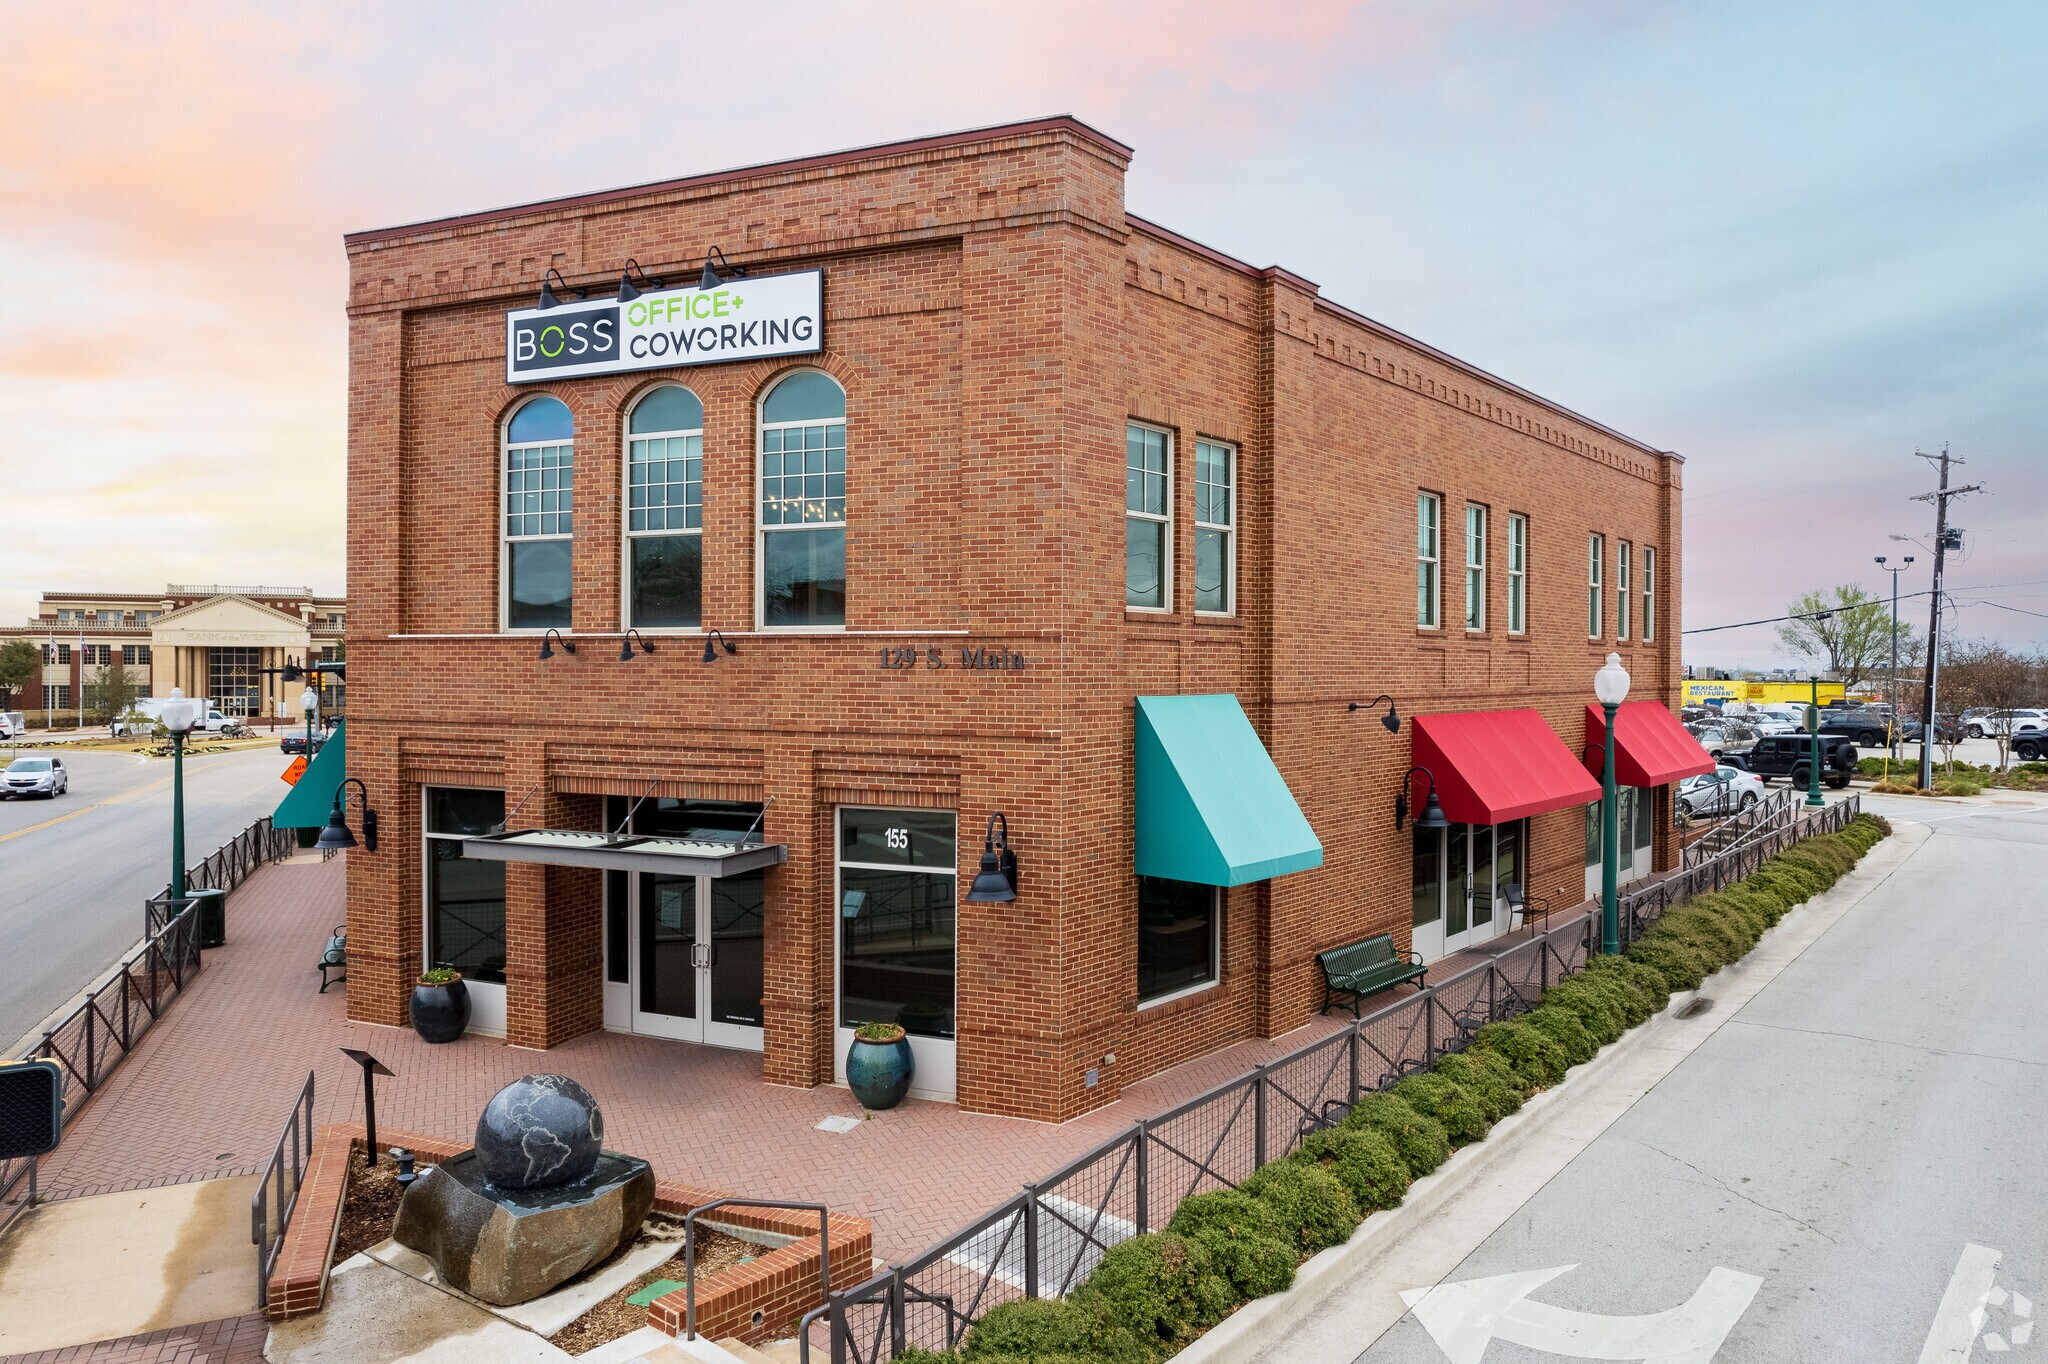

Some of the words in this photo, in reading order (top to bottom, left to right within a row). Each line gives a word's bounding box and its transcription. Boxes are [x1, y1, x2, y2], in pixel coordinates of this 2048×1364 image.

[627, 290, 744, 327] OFFICE+
[516, 318, 613, 362] BOSS
[629, 315, 813, 359] COWORKING
[186, 633, 220, 641] BANK
[239, 633, 275, 641] WEST
[880, 647, 916, 669] 129
[926, 647, 947, 669] S.
[960, 647, 1024, 669] Main
[884, 827, 908, 849] 155
